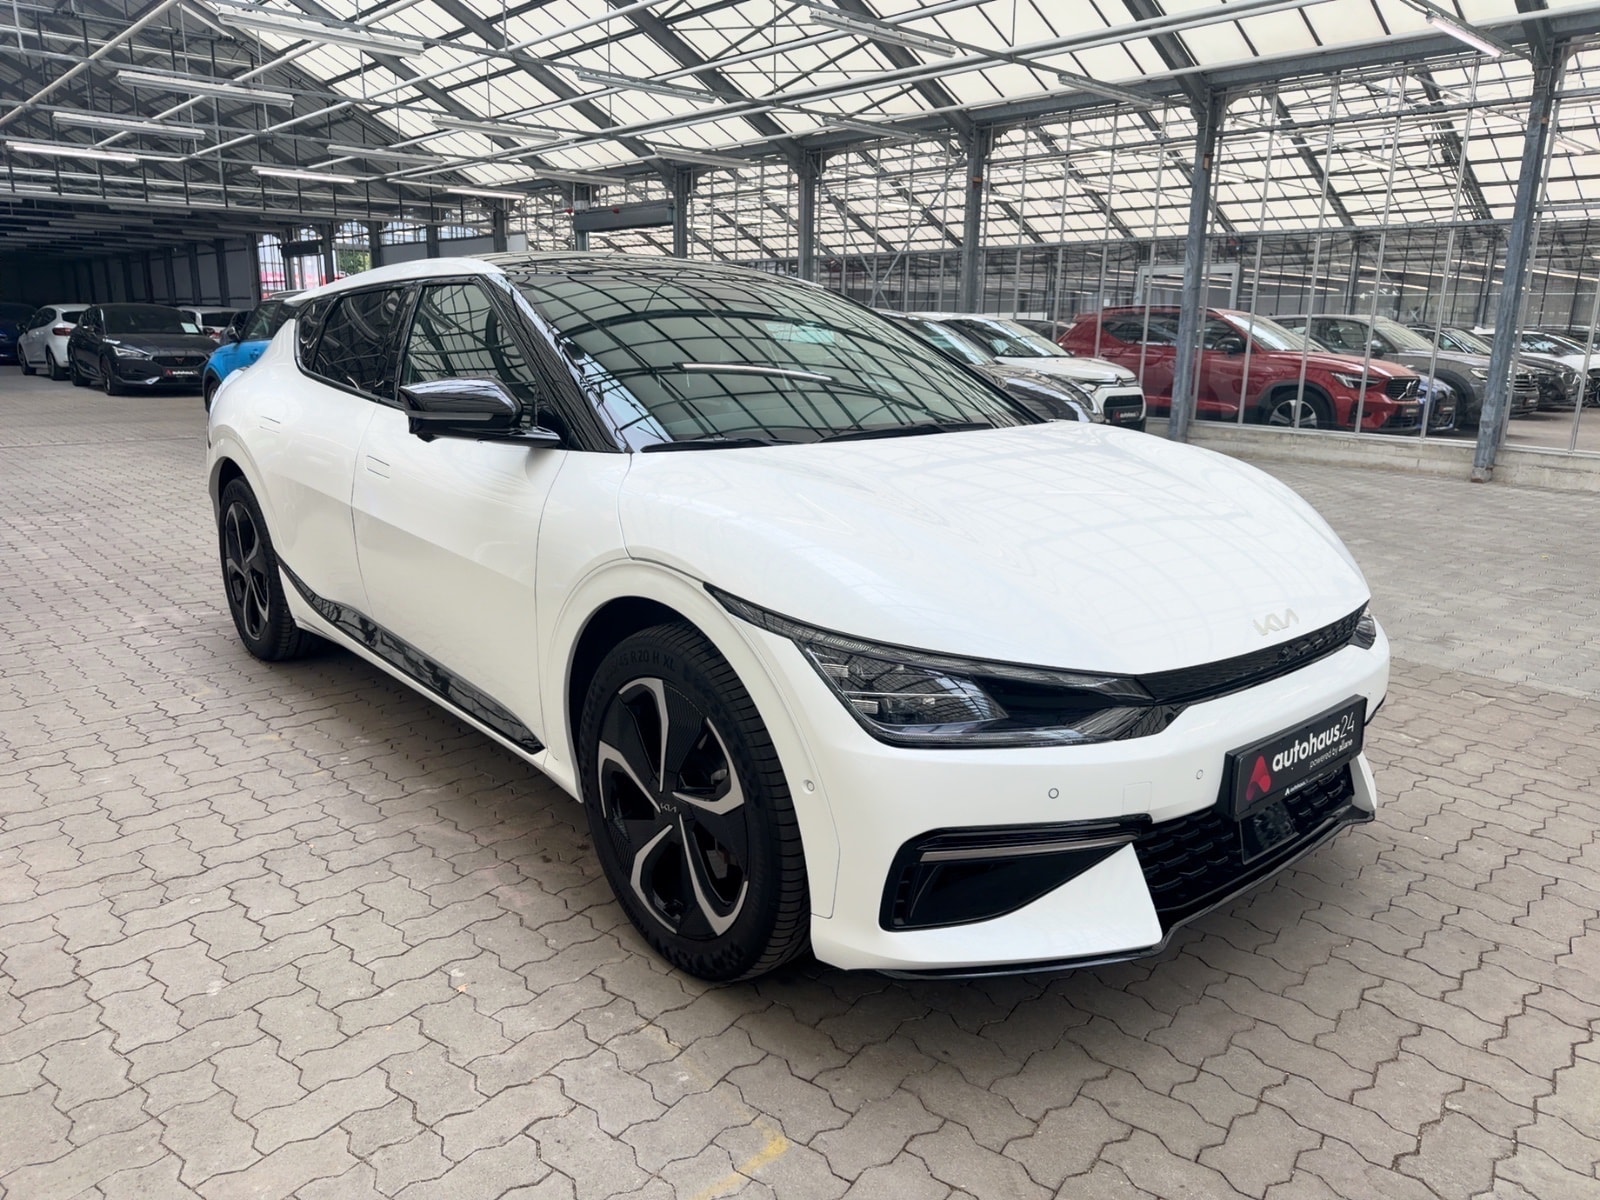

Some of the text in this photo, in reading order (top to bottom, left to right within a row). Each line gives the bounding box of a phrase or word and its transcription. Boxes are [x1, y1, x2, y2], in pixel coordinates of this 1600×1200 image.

[1252, 608, 1299, 636] KIA
[631, 650, 649, 664] R20
[653, 650, 660, 665] H
[1272, 712, 1355, 772] autohaus24
